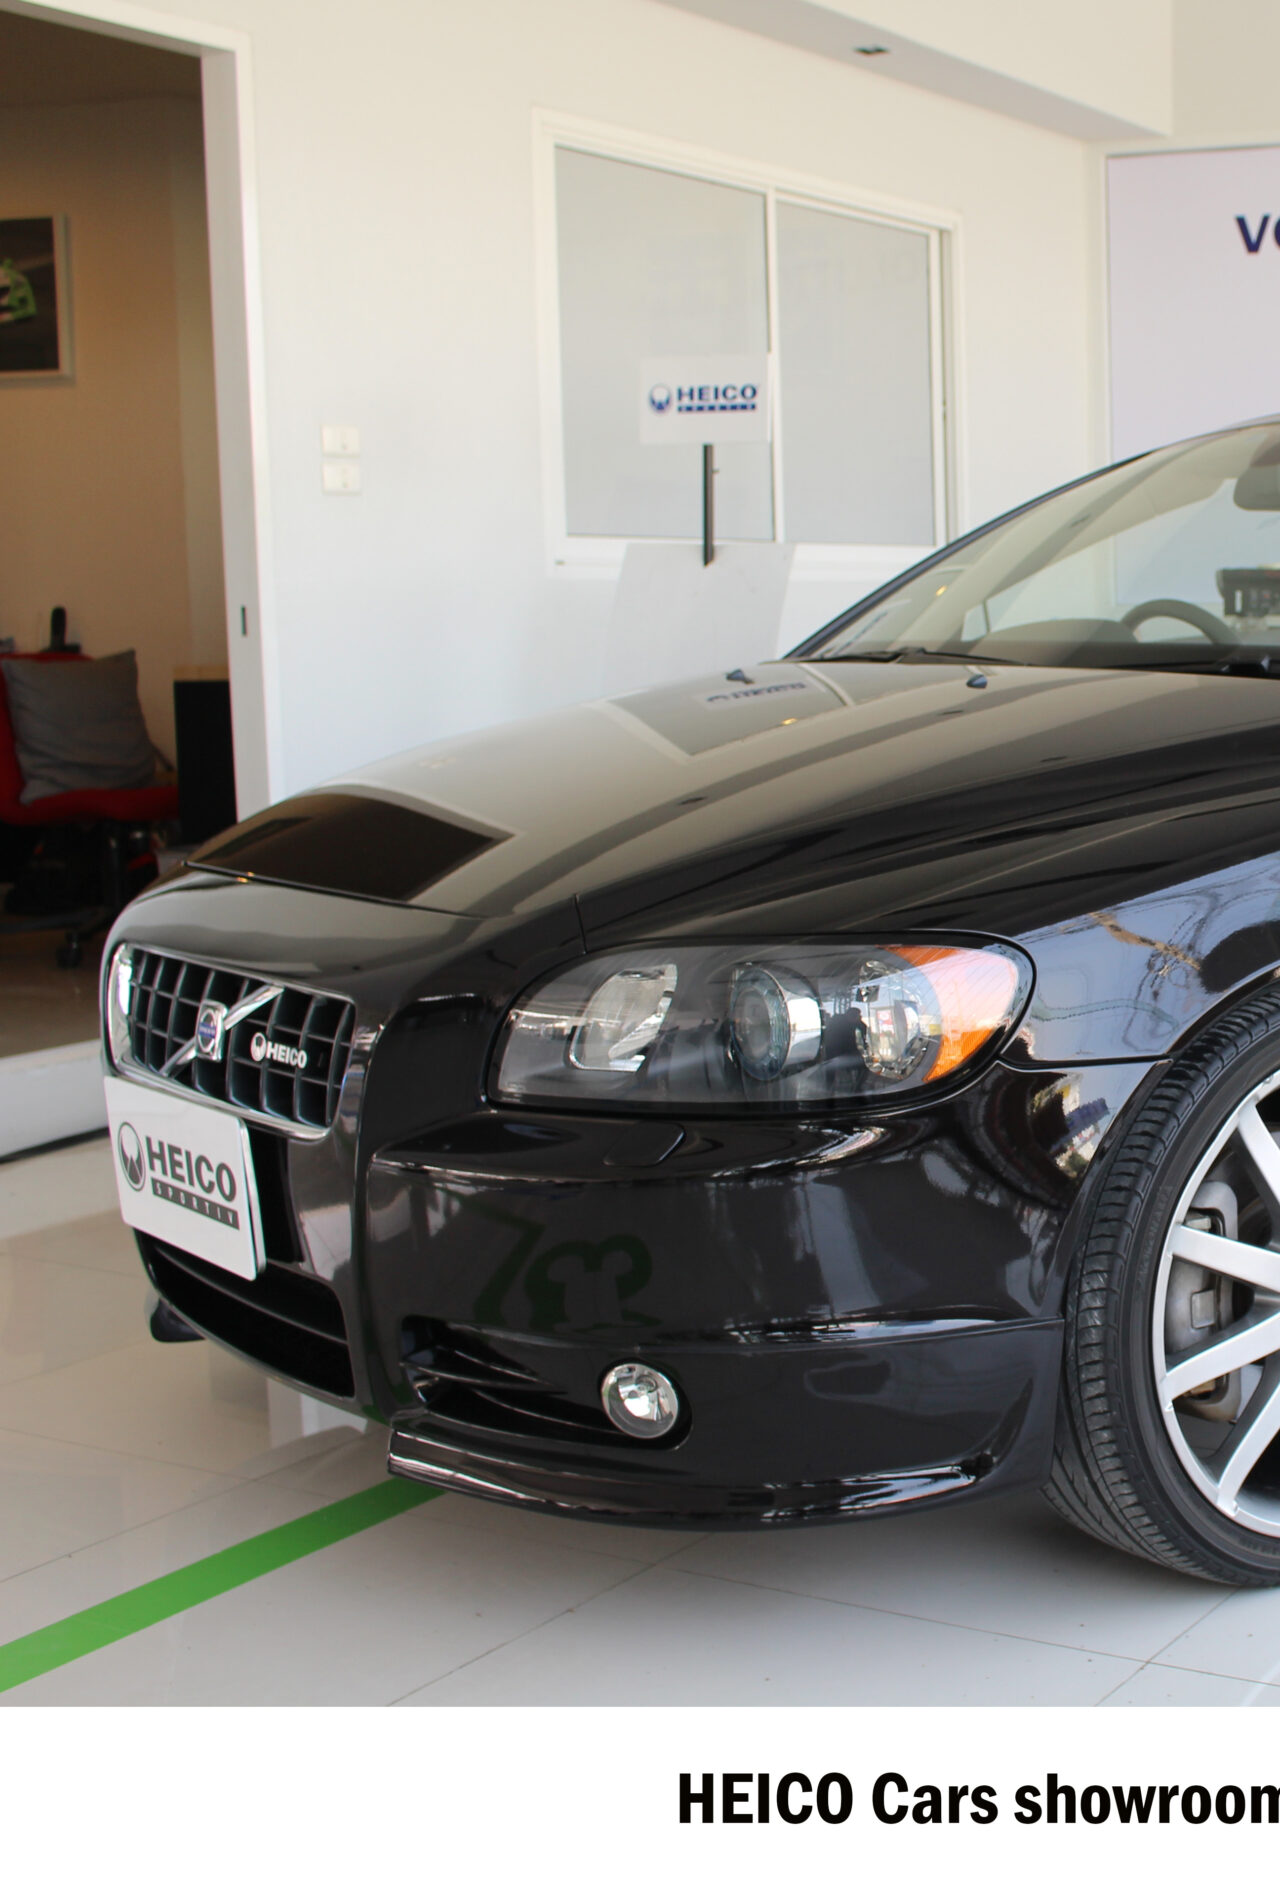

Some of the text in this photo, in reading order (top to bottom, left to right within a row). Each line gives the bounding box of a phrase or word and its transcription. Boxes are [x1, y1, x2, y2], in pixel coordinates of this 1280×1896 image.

[677, 384, 758, 402] HEICO
[266, 1041, 308, 1069] HEICO
[146, 1135, 238, 1203] HEICO
